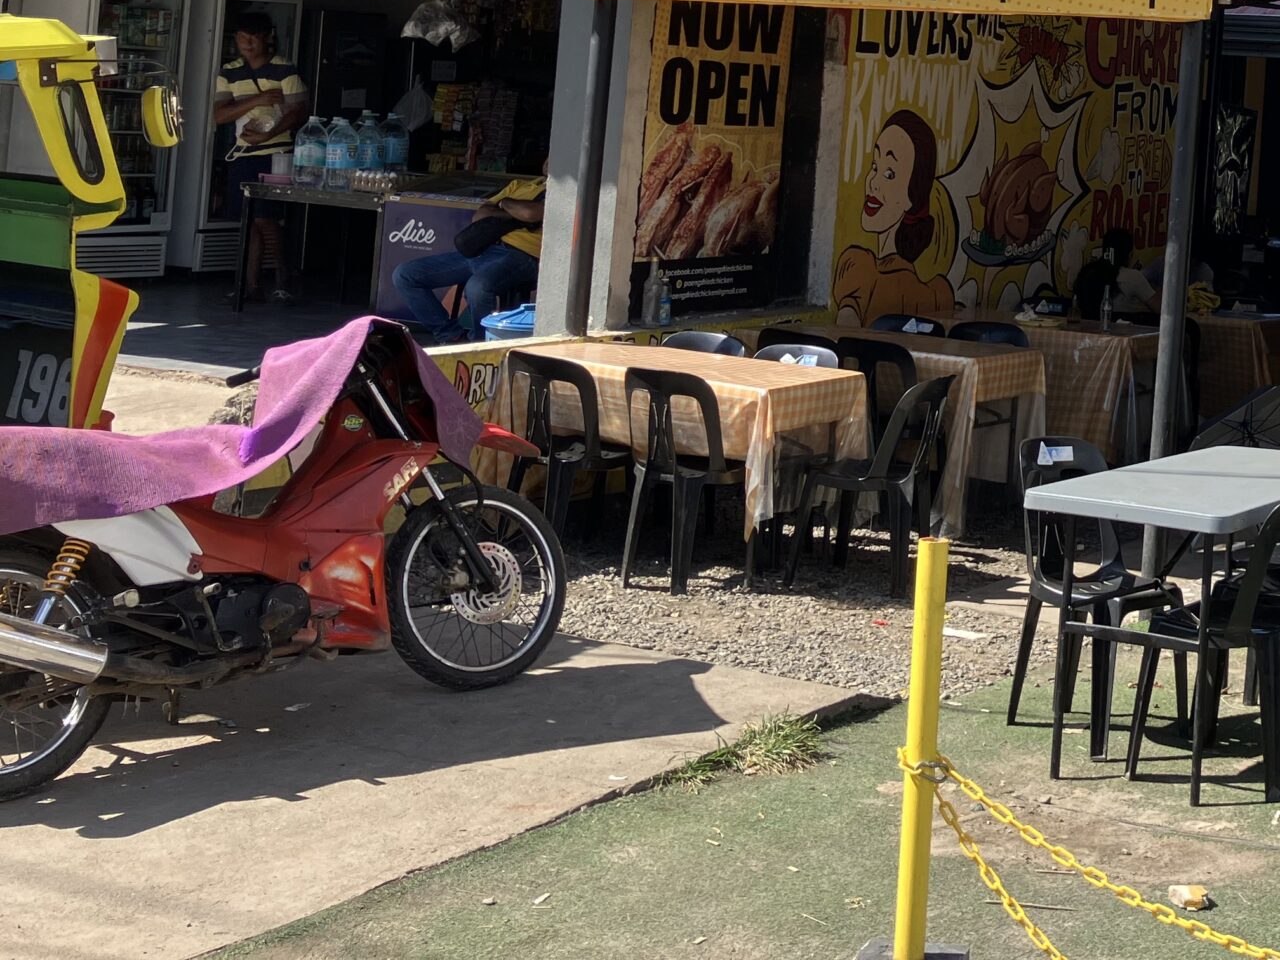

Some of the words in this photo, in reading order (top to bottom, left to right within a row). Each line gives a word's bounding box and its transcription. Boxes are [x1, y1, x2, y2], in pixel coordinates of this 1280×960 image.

[667, 1, 785, 55] NOW
[659, 56, 781, 127] OPEN
[389, 218, 436, 244] Aice
[454, 359, 500, 406] DRU
